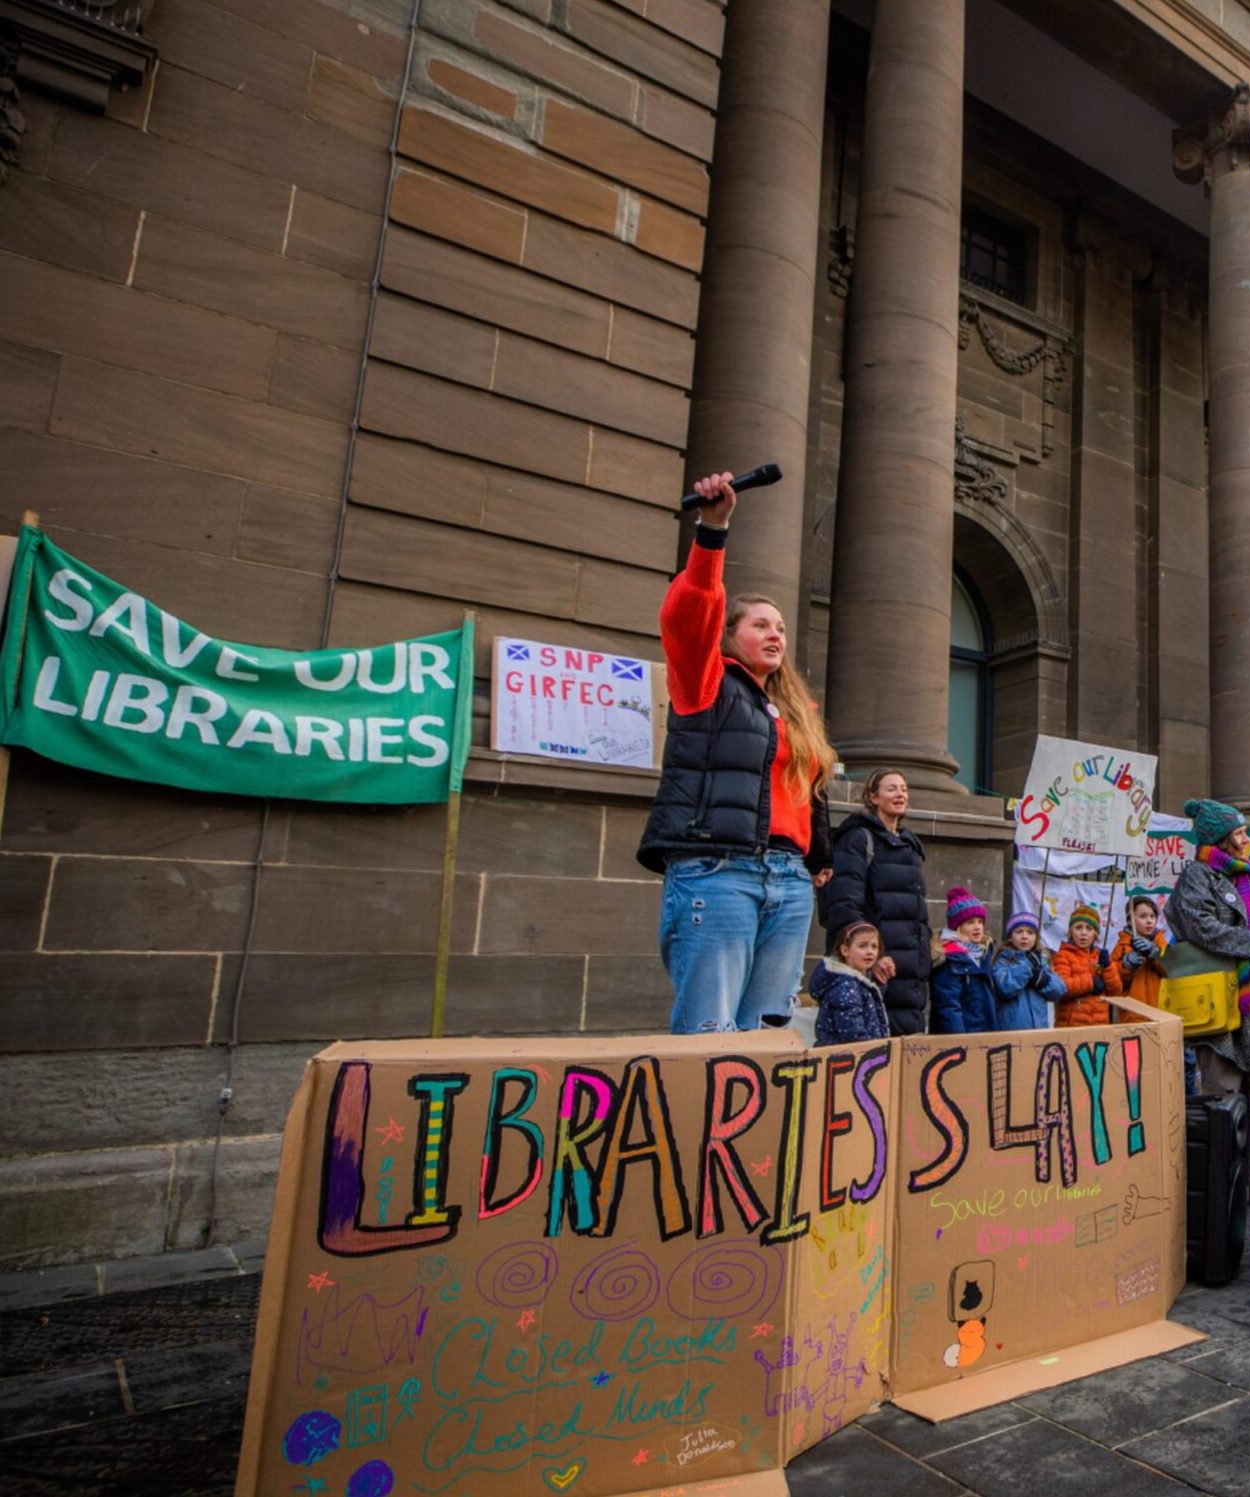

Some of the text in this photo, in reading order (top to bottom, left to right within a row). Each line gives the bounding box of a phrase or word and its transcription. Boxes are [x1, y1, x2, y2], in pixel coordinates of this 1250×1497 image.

[44, 569, 456, 694] SAVE OUR
[540, 647, 604, 673] SNP
[32, 656, 451, 767] LIBRARIES
[505, 671, 615, 707] GIRFEC
[1020, 776, 1069, 842] Save
[1072, 754, 1105, 783] our
[1146, 836, 1186, 857] SAVE
[318, 1036, 1146, 1258] LIBRARIES SLAY!
[930, 1190, 1006, 1230] Save
[1014, 1184, 1055, 1209] our
[432, 1317, 737, 1400] Closed Books
[423, 1379, 714, 1472] Closed Minds
[680, 1428, 720, 1451] Julia
